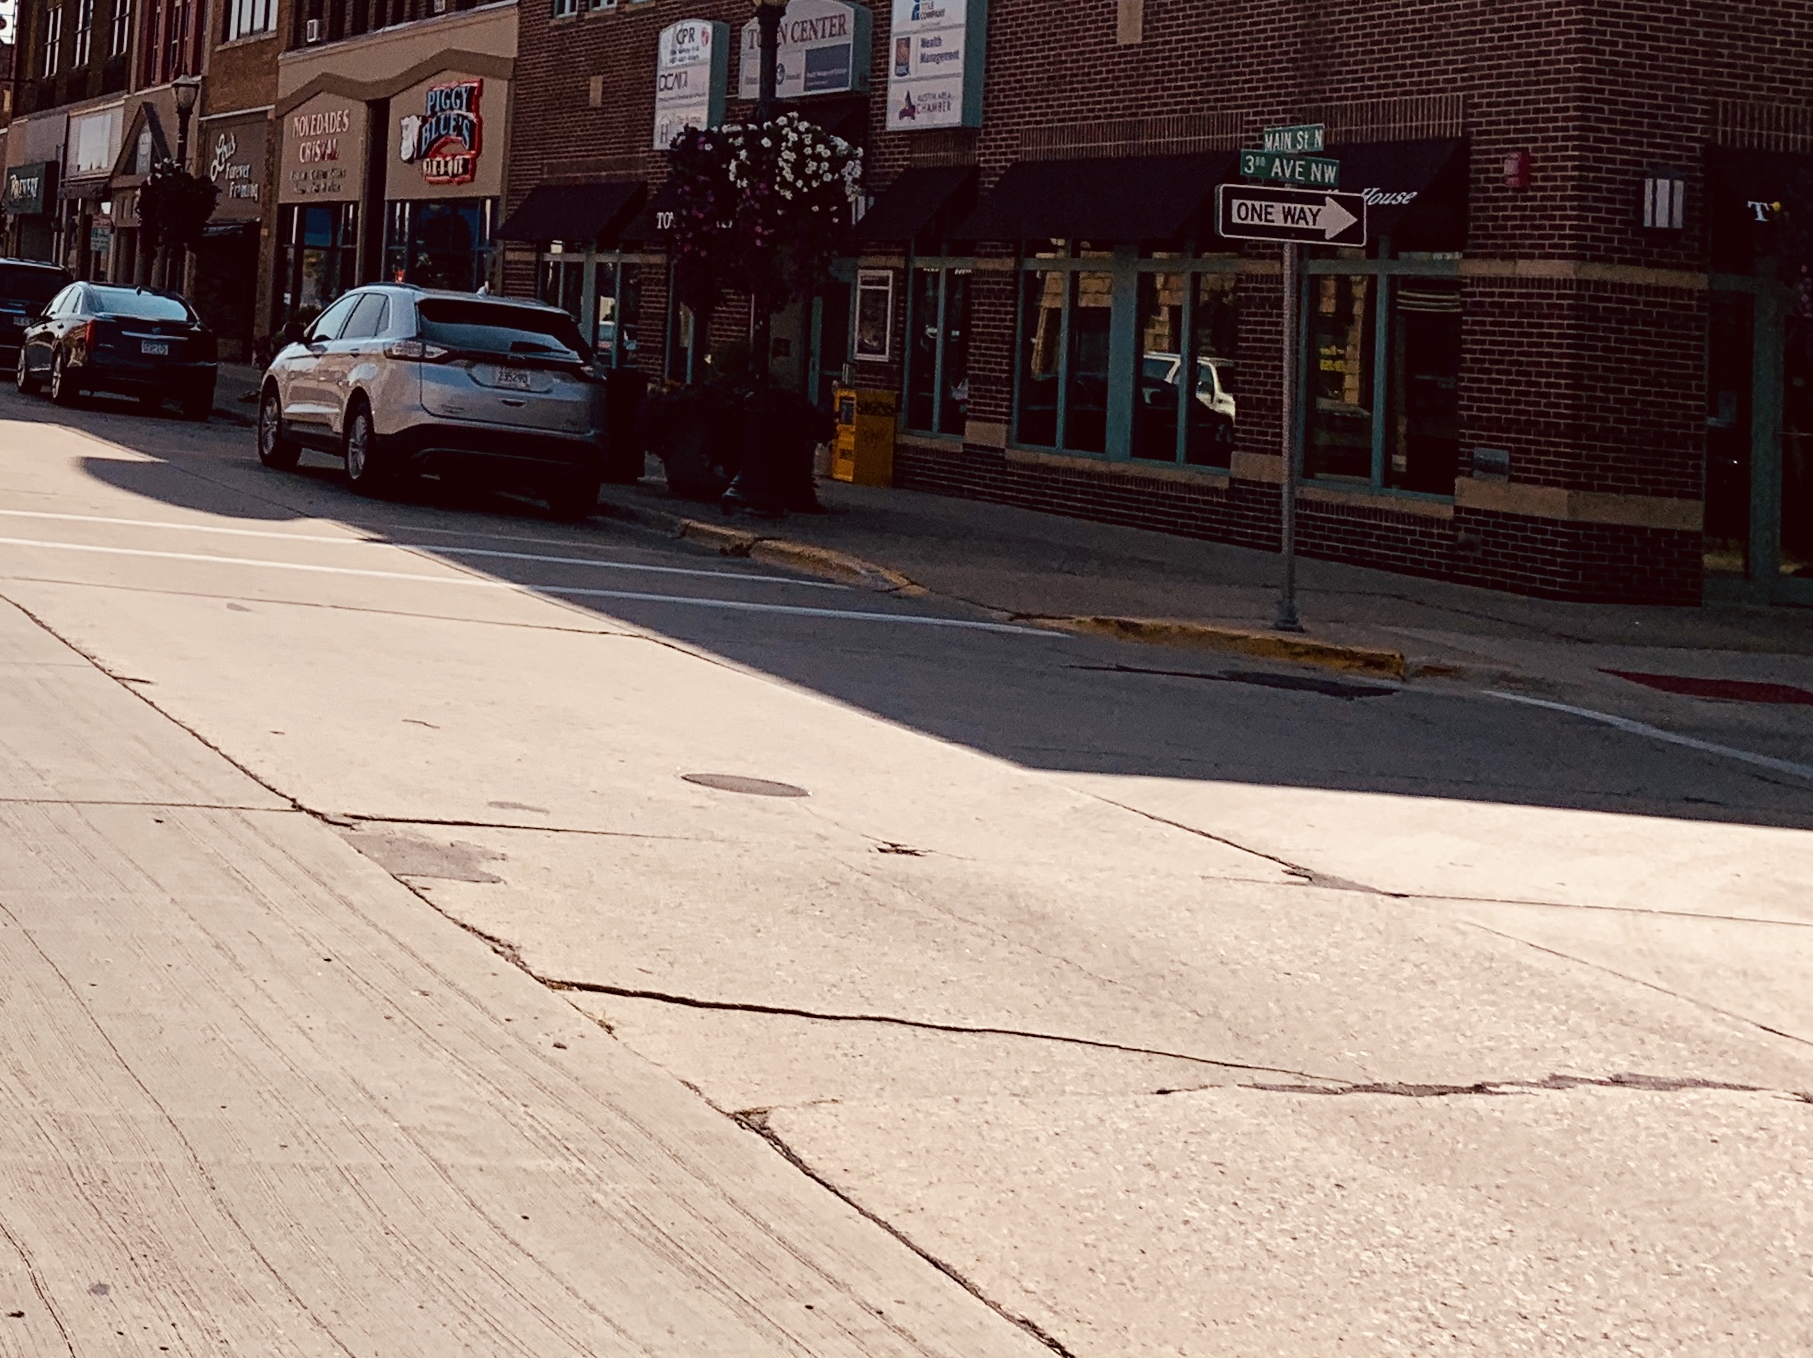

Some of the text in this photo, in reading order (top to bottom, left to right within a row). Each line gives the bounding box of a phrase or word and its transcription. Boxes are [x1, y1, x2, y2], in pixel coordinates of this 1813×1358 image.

[676, 27, 695, 45] CPR
[790, 13, 847, 44] CENTER
[920, 35, 942, 48] Wealth
[920, 50, 960, 65] Management
[427, 86, 471, 117] PIGGY
[916, 100, 952, 115] CHAMBER
[292, 108, 349, 139] NOVEDADES
[420, 113, 471, 157] BLUE'S
[1264, 131, 1292, 152] MAIN
[1314, 129, 1323, 149] N
[1271, 159, 1305, 181] AVE
[1310, 163, 1337, 184] NW
[1361, 187, 1418, 206] House
[1237, 202, 1321, 227] ONE WAY
